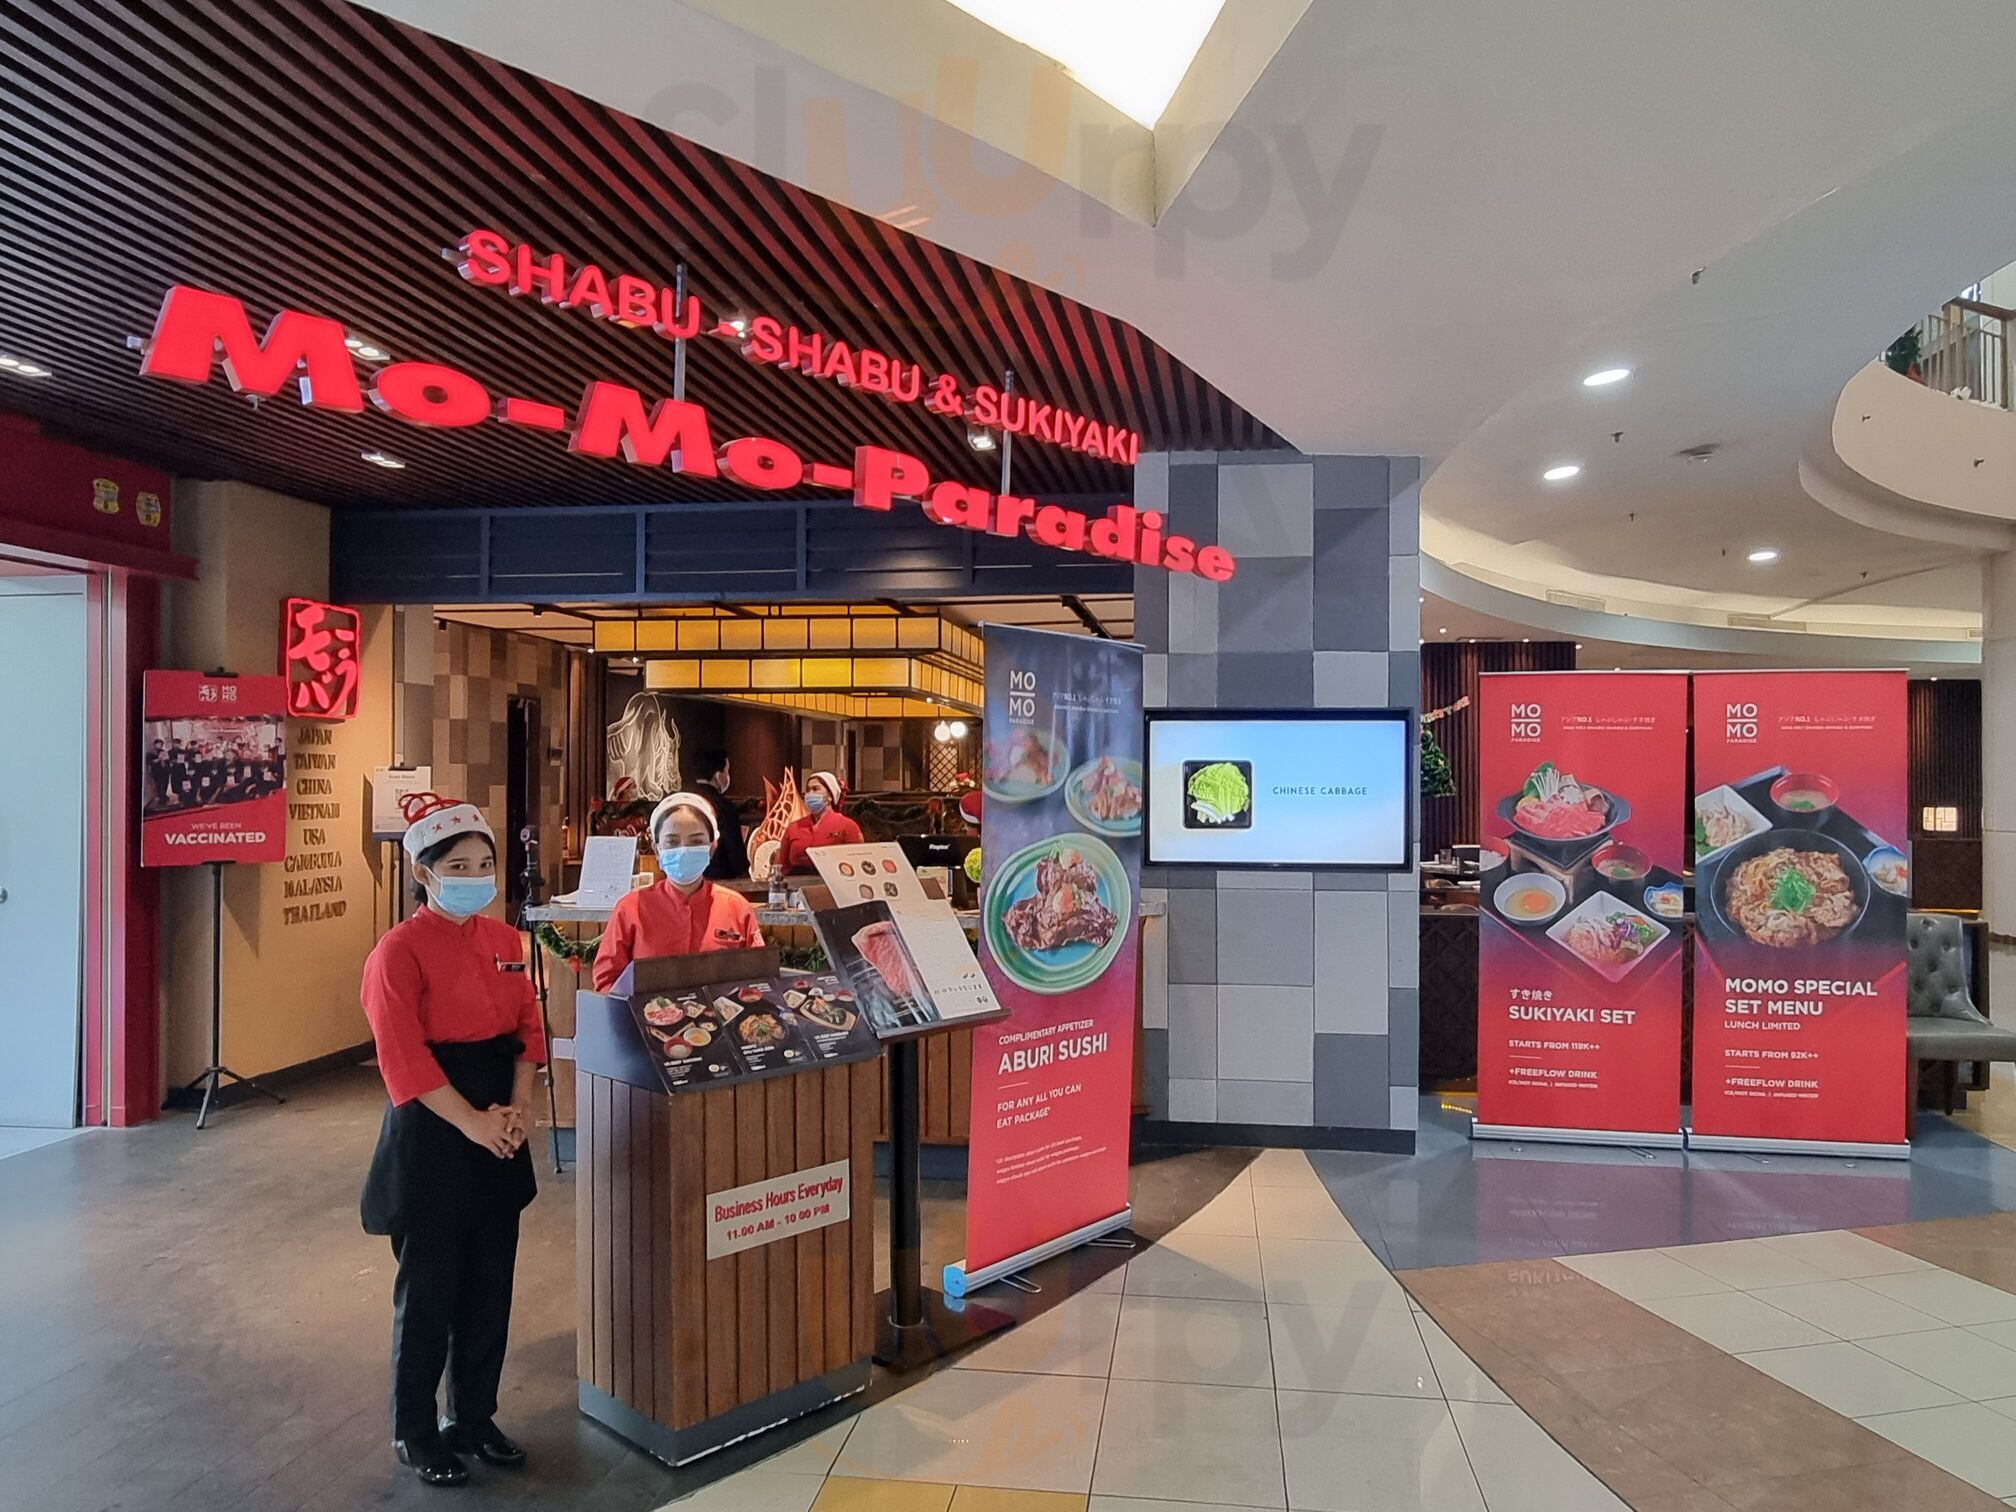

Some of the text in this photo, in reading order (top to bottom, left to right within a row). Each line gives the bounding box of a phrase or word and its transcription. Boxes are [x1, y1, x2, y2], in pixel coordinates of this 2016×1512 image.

[460, 229, 701, 339] SHABU
[744, 315, 920, 402] SHABU
[929, 373, 962, 418] &
[970, 384, 1139, 465] SUKIYAKI
[142, 285, 1237, 581] Mo-Mo-Paradise
[1010, 670, 1036, 691] MO
[1009, 697, 1035, 717] MO
[1511, 704, 1541, 718] MO
[1726, 703, 1758, 718] MO
[298, 728, 332, 745] JAPAN
[1511, 723, 1541, 737] MO
[1726, 723, 1758, 738] MO
[294, 753, 336, 770] TAIWAN
[297, 778, 332, 795] CHINA
[1272, 786, 1368, 795] CHINESE CABBAGE
[288, 802, 341, 820] VIETNAM
[219, 821, 242, 830] BEEN
[165, 831, 266, 845] VACCINATED
[303, 828, 326, 846] USA
[284, 850, 343, 873] CAMBODIA
[284, 875, 343, 899] MALAYSIA
[283, 900, 347, 926] THAILAND
[1725, 977, 1878, 996] MOMO SPECIAL
[1508, 1005, 1636, 1025] SUKIYAKI SET
[1724, 999, 1824, 1016] SET MENU
[998, 1018, 1094, 1046] COMPLIMENTARY APPETIZER
[1724, 1020, 1801, 1031] LUNCH LIMITED
[998, 1031, 1108, 1075] ABURI SUSHI
[1508, 1039, 1541, 1049] STARTS
[1543, 1041, 1569, 1050] FROM
[1724, 1049, 1759, 1058] STARTS
[1761, 1050, 1789, 1059] FROM
[1567, 1069, 1598, 1079] DRINK
[1787, 1079, 1819, 1089] DRINK
[997, 1083, 1082, 1113] FOR ANY ALL YOU CAN
[996, 1116, 1013, 1129] EAT
[714, 1176, 844, 1223] Business Hours Everyday
[726, 1223, 754, 1241] 11.00
[756, 1217, 775, 1232] AM
[813, 1203, 830, 1217] PM
